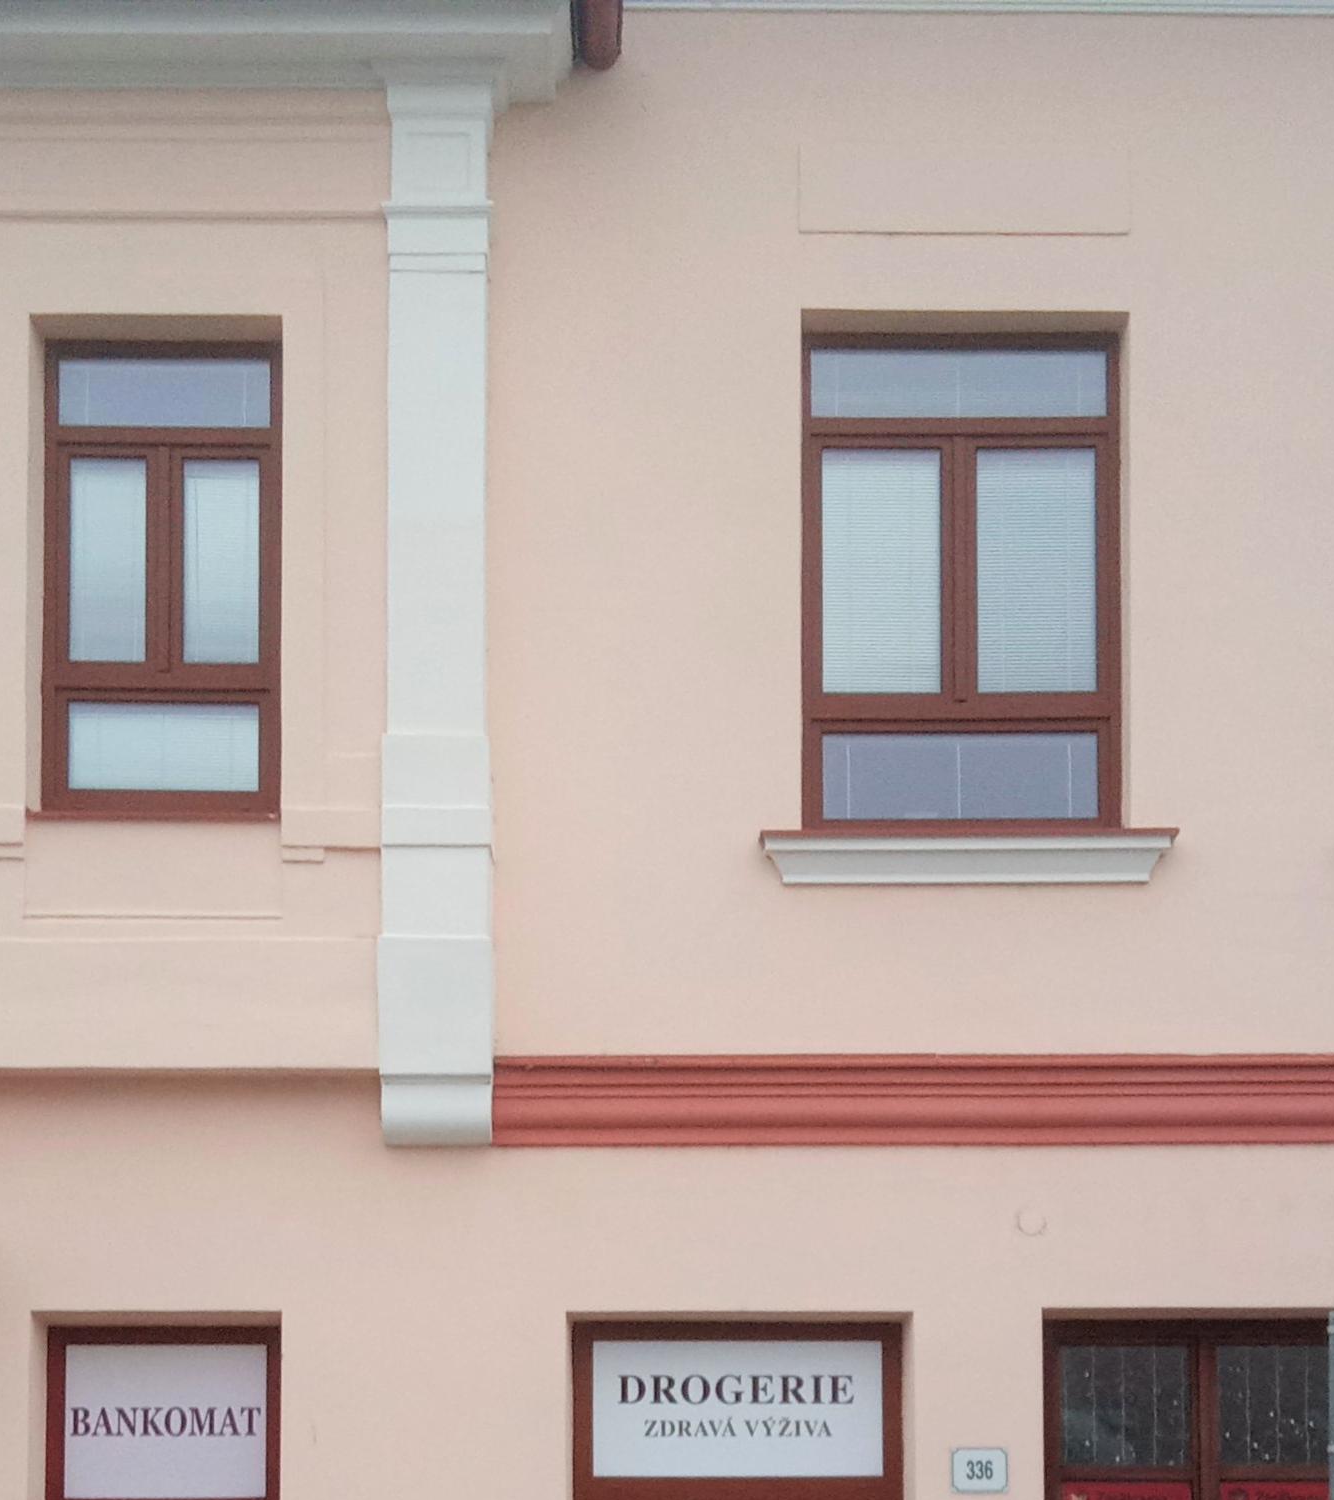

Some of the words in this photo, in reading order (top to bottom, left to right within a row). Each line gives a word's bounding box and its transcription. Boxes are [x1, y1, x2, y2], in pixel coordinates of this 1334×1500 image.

[617, 1374, 855, 1405] DROGERIE
[70, 1406, 262, 1438] BANKOMAT
[644, 1415, 737, 1439] ZDRAVÁ
[744, 1415, 833, 1439] VÝŽIVA
[966, 1459, 994, 1480] 336
